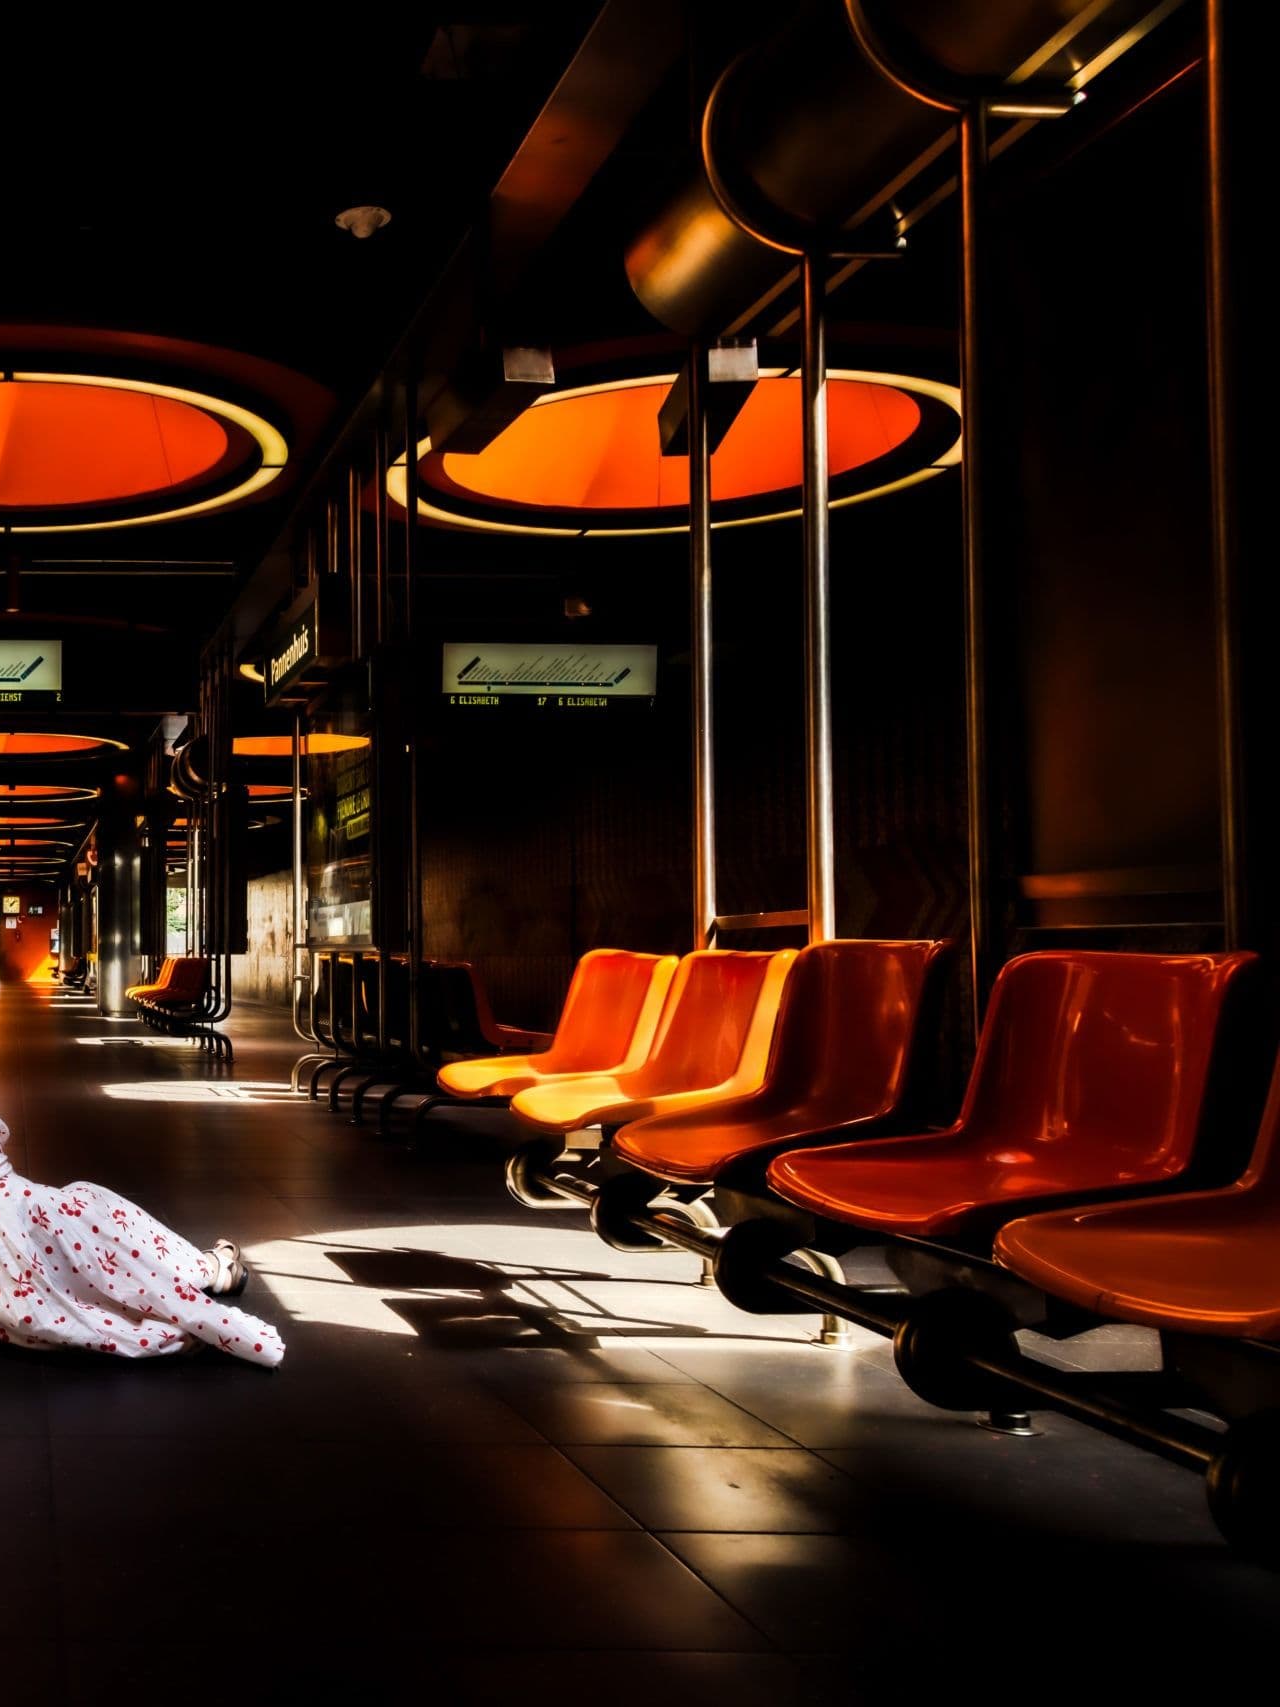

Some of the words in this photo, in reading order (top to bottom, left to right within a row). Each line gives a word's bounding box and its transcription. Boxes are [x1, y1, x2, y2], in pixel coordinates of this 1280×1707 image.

[271, 624, 309, 686] Pannenhuis
[459, 696, 499, 705] ELISABETH
[538, 697, 547, 706] 17
[567, 697, 608, 706] ELISABETH
